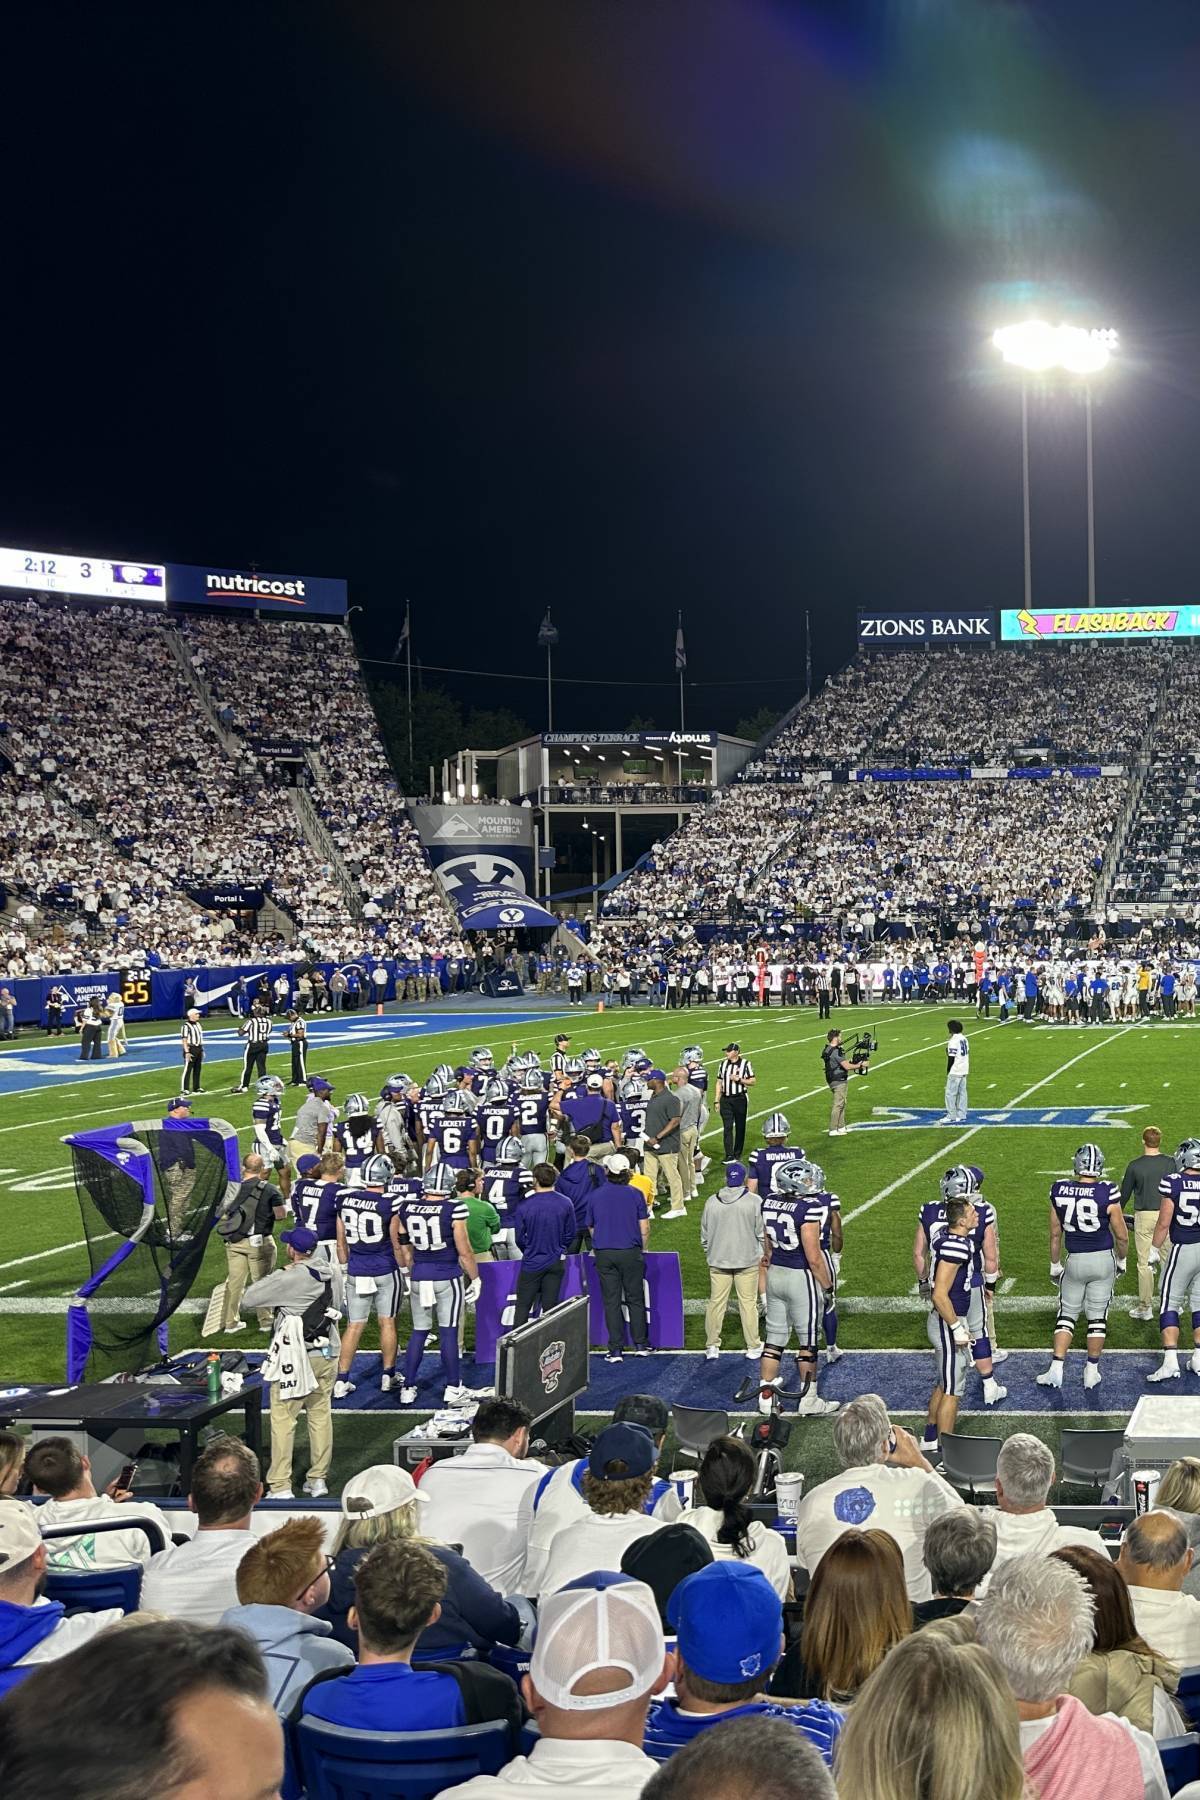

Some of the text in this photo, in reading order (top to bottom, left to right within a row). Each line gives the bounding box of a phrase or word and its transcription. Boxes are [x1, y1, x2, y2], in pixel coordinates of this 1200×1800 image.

[24, 558, 56, 574] 2:12
[80, 563, 92, 578] 3
[206, 574, 305, 596] nutricost
[860, 618, 990, 636] ZIONS BANK
[1053, 611, 1170, 633] FLASHBACK
[544, 734, 640, 742] CHAMPIONS TERRACE
[669, 731, 711, 743] smarty
[261, 746, 280, 754] Portal
[478, 816, 522, 826] MOUNTAIN
[481, 825, 520, 834] AMERICA
[127, 969, 150, 981] 2:12
[74, 984, 108, 994] MOUNTAIN
[124, 982, 149, 1003] 25
[482, 1108, 510, 1116] JACKSON
[521, 1101, 538, 1125] 2
[631, 1109, 647, 1132] 3
[486, 1115, 504, 1140] 0
[343, 1130, 373, 1155] 14
[443, 1128, 461, 1154] 6
[765, 1152, 796, 1161] BOWMAN
[485, 1170, 514, 1179] JACKSON
[388, 1184, 409, 1192] KOCH
[489, 1179, 508, 1209] 4
[1058, 1185, 1095, 1197] PASTORE
[342, 1197, 378, 1211] ANCIAUX
[303, 1197, 319, 1231] 7
[1055, 1197, 1101, 1233] 78
[341, 1208, 383, 1244] 80
[406, 1215, 447, 1251] 81
[763, 1212, 800, 1251] 53
